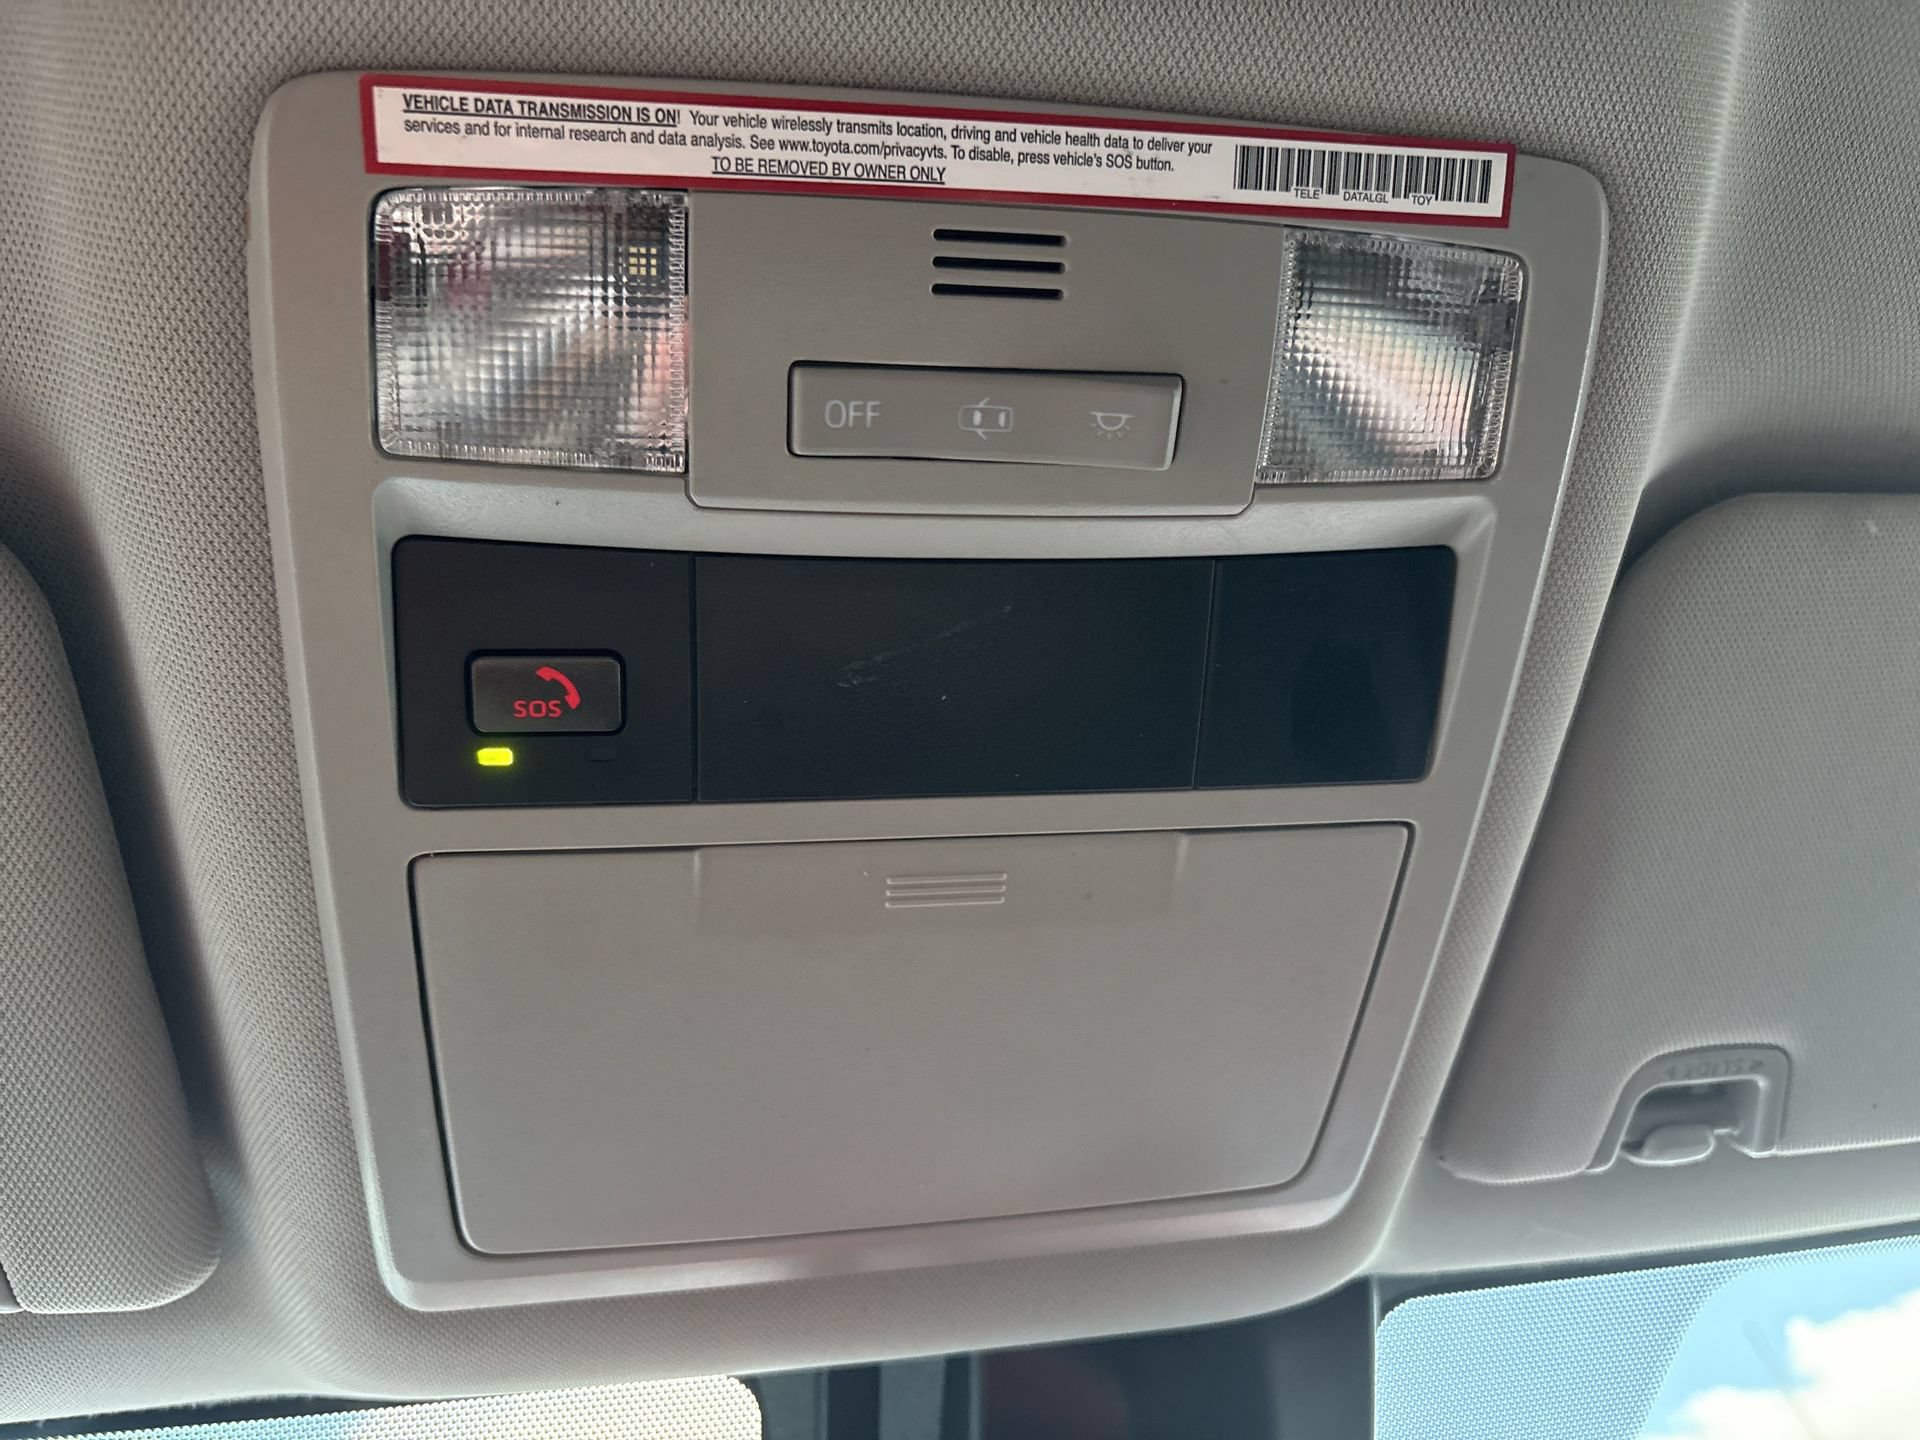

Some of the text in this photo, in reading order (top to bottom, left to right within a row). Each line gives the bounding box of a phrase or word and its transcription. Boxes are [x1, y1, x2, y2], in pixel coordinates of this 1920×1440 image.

[402, 94, 1212, 156] VEHICLE DATA TRANSMISSION IS ON! Your vehicle wirelessly transmits location, driving and vehicle health data to deliver your
[404, 118, 1174, 172] services and for internal research and data analysis. See www.toyota.com/privacyvts. To disable, press vehicle's SOS button.
[712, 156, 946, 182] TO BE REMOVED BY OWNER ONLY
[1293, 188, 1433, 206] TELE DATALGL TOY
[824, 400, 882, 430] OFF
[512, 700, 563, 719] SOS
